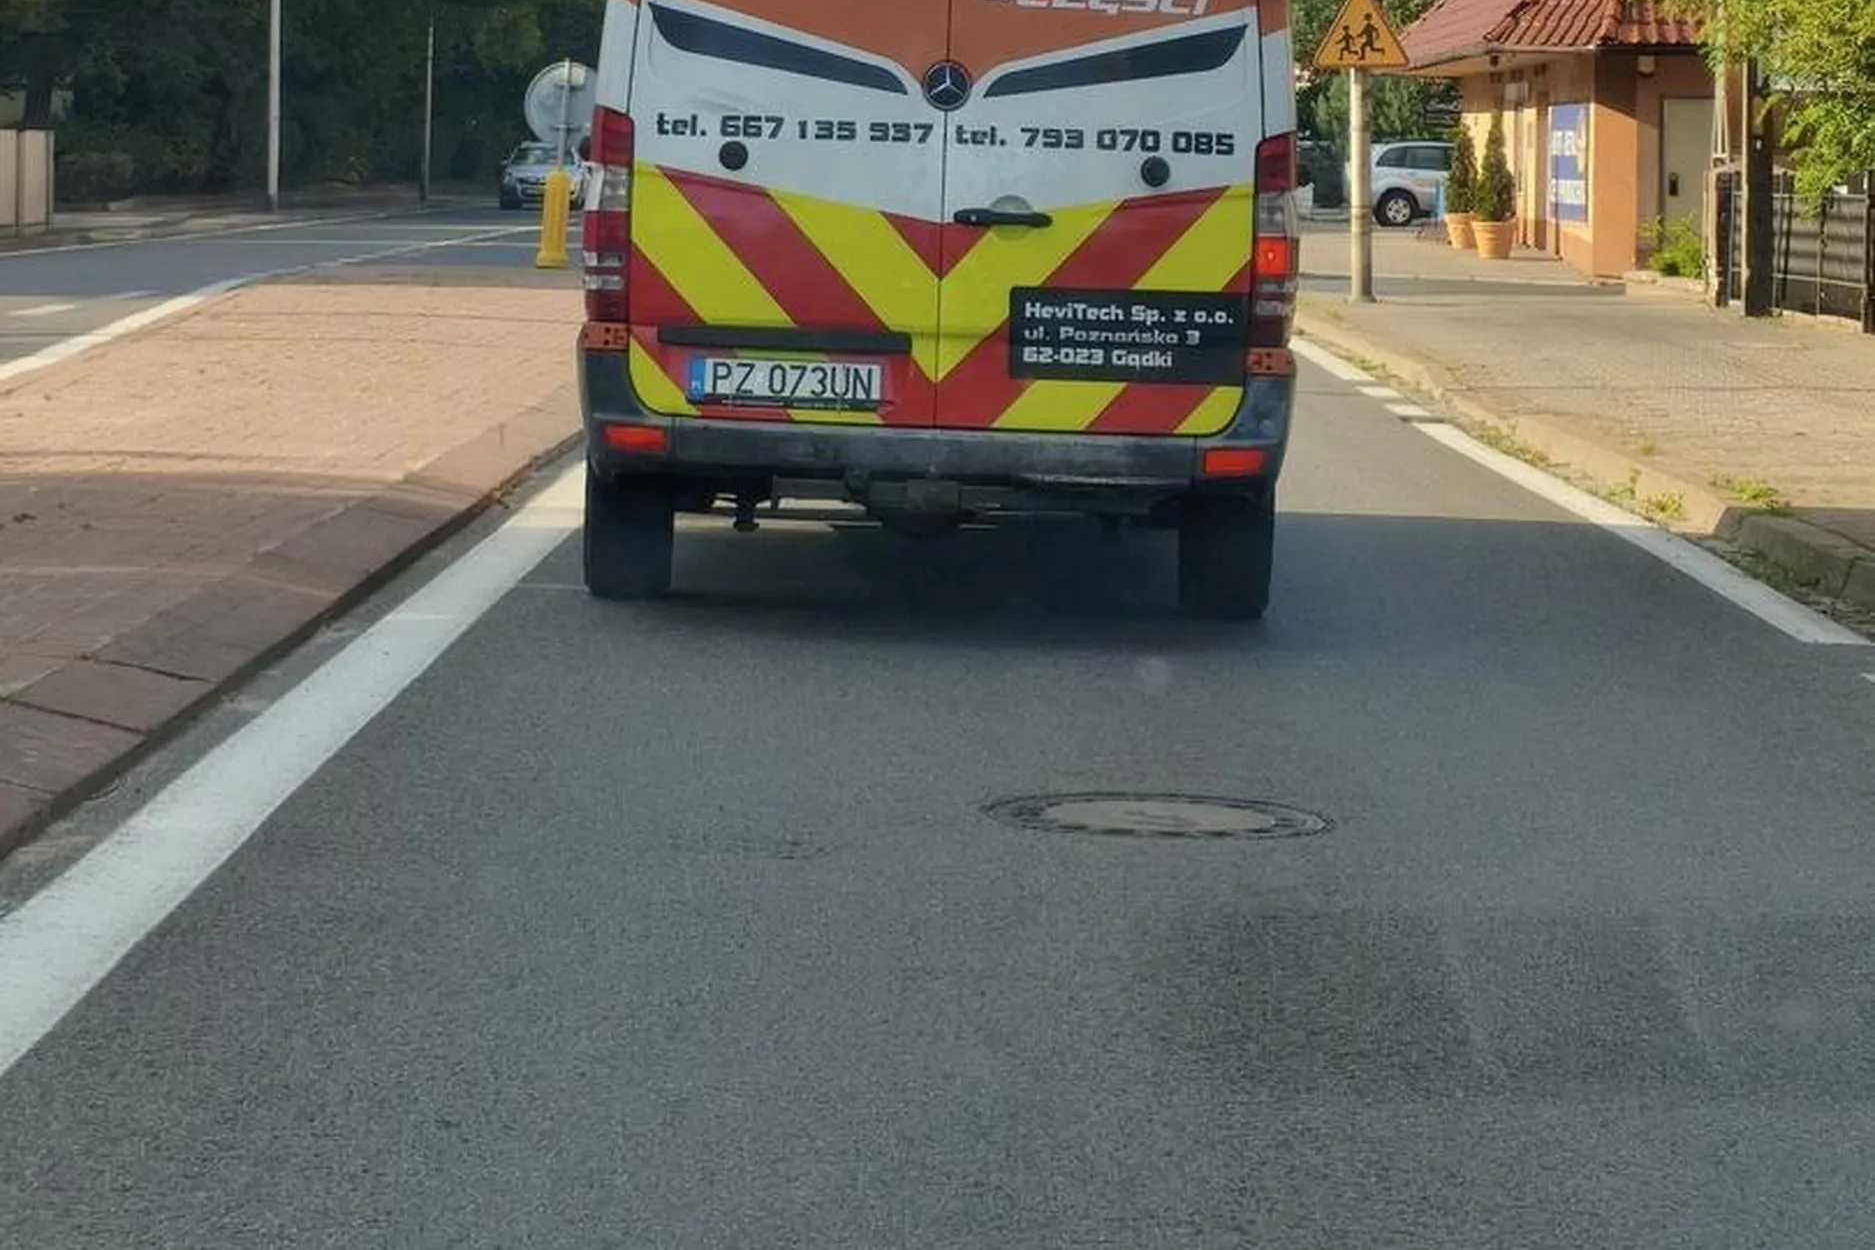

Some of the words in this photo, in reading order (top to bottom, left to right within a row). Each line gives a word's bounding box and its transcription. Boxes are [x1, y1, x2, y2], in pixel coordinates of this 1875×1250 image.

[656, 113, 707, 137] tel.
[720, 115, 785, 139] 667
[798, 120, 856, 141] 135
[955, 125, 1006, 147] tel.
[1020, 127, 1084, 150] 793
[1096, 129, 1160, 151] 070
[1171, 132, 1235, 156] 085
[1025, 303, 1124, 321] HeviTech
[1131, 306, 1166, 325] Sp.
[1174, 310, 1187, 322] z
[1194, 310, 1234, 324] o.o.
[1024, 328, 1050, 341] ul.
[1059, 326, 1179, 344] Poznańska
[1185, 330, 1201, 345] 3
[1022, 347, 1104, 365] 62-023
[712, 362, 756, 394] PZ
[768, 364, 873, 399] 073UN
